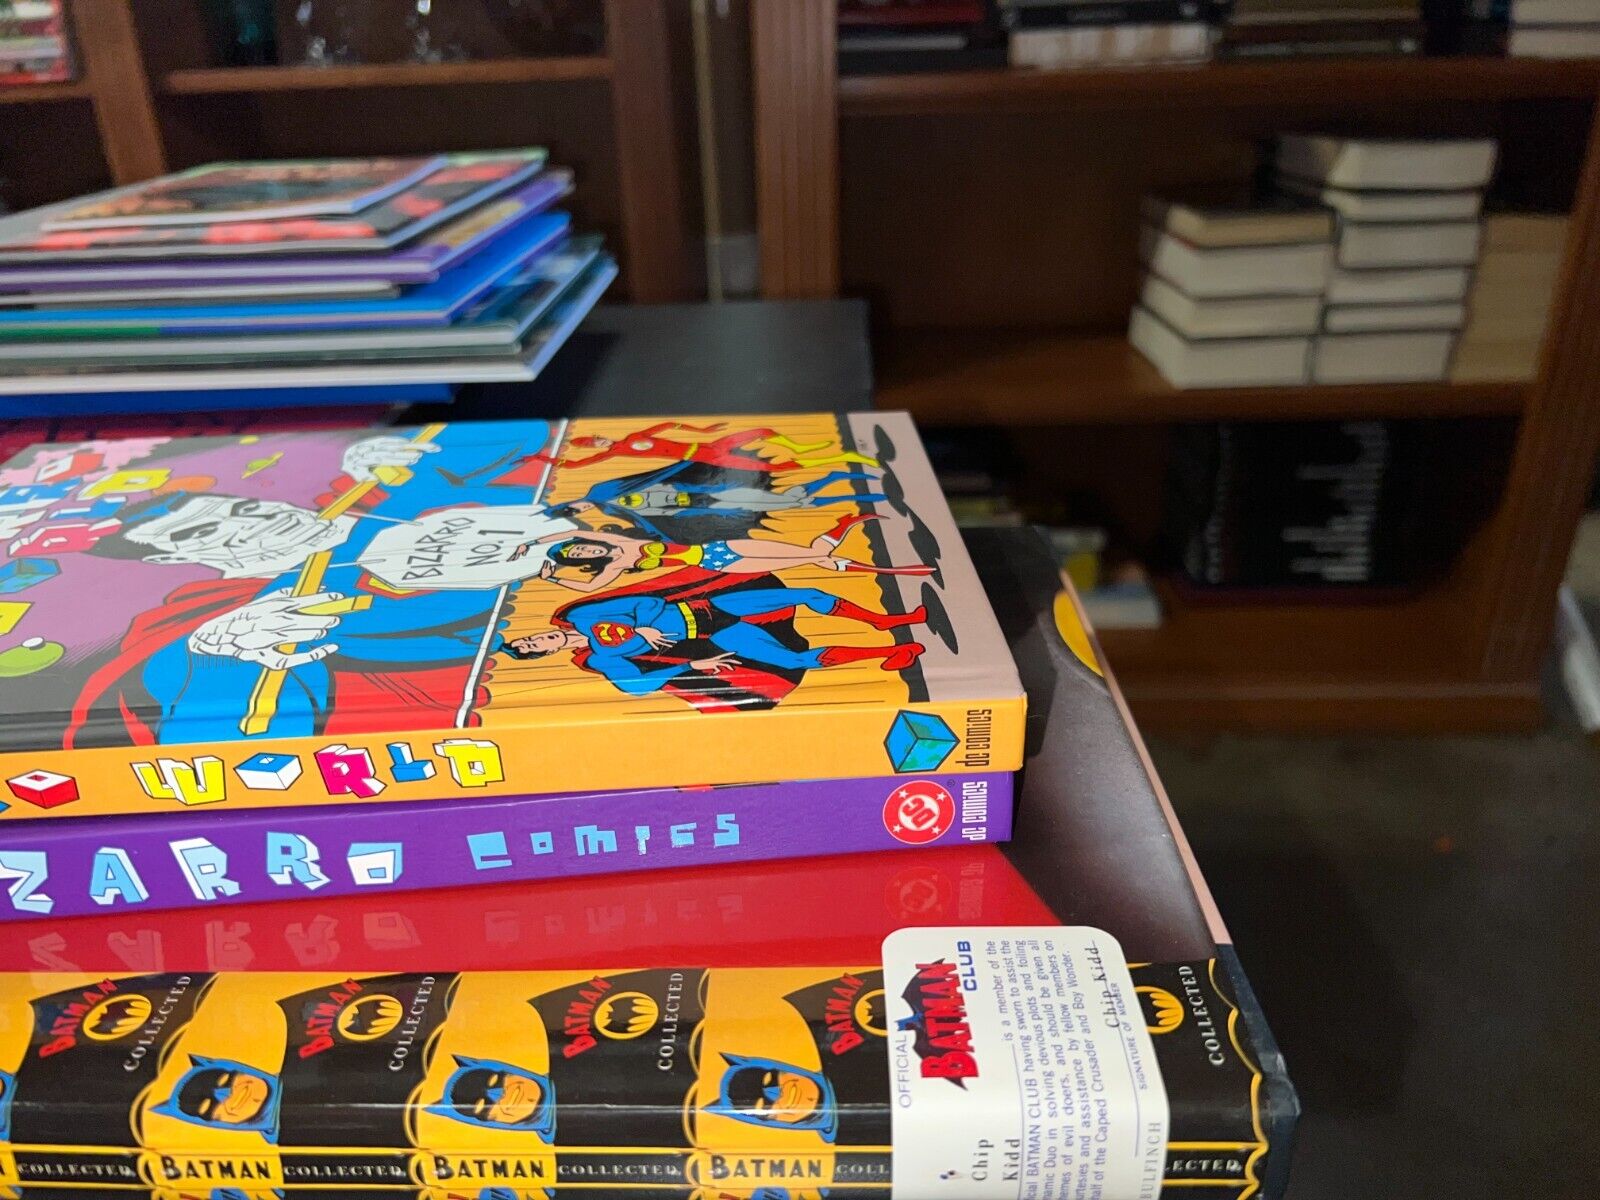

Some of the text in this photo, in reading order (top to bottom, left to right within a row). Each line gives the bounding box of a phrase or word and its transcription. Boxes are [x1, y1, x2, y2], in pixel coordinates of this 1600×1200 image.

[402, 517, 476, 580] BIZARRO
[130, 738, 504, 806] WORLD
[0, 831, 403, 913] ZARRO
[986, 940, 997, 955] the
[1000, 940, 1011, 954] the
[1016, 940, 1028, 968] foiling
[1028, 940, 1039, 951] all
[1044, 940, 1055, 951] on
[957, 940, 977, 991] CLUB
[988, 960, 1000, 968] of
[1003, 957, 1017, 983] assist
[1033, 956, 1049, 981] given
[1048, 954, 1065, 997] members
[993, 975, 1008, 1014] member
[1010, 987, 1021, 997] to
[1021, 973, 1034, 991] and
[1040, 986, 1051, 999] be
[1085, 947, 1120, 1028] Chip Kidd
[825, 972, 865, 1055] BATMAN
[1027, 996, 1042, 1021] plots
[1072, 991, 1085, 1009] Boy
[39, 978, 119, 1058] BATMAN
[123, 975, 192, 1072] COLLECTED
[298, 977, 364, 1058] BATMAN
[388, 976, 436, 1072] COLLECTED
[562, 975, 613, 1058] BATMAN
[657, 972, 684, 1071] COLLECTED
[915, 963, 979, 1079] BATMAN
[1013, 1001, 1027, 1030] sworn
[1042, 1004, 1060, 1038] should
[1060, 1004, 1075, 1033] fellow
[1076, 1014, 1091, 1034] and
[1178, 965, 1225, 1066] COLLECTED
[1004, 1032, 1013, 1041] is
[1034, 1025, 1050, 1066] devious
[1067, 1038, 1080, 1051] by
[1110, 982, 1148, 1090] SIGNATURE OF MEMBER
[1020, 1035, 1035, 1072] having
[1051, 1044, 1066, 1066] and
[1084, 1039, 1104, 1092] Crusader
[896, 1035, 912, 1108] OFFICIAL
[1024, 1078, 1041, 1118] CLUB
[1042, 1070, 1057, 1118] solving
[1072, 1058, 1091, 1128] assistance
[1045, 1128, 1057, 1139] in
[1095, 1099, 1111, 1142] Caped
[1026, 1124, 1041, 1177] BATMAN
[1062, 1125, 1074, 1147] evil
[1079, 1135, 1091, 1158] and
[160, 1155, 272, 1180] BATMAN
[433, 1154, 544, 1180] BATMAN
[556, 1163, 681, 1178] COLLECTED
[709, 1153, 823, 1181] BATMAN
[972, 1139, 994, 1181] Chip
[1003, 1139, 1021, 1181] Kidd
[1043, 1146, 1057, 1168] Duo
[1061, 1154, 1073, 1165] of
[1094, 1147, 1107, 1165] the
[1140, 1122, 1162, 1199] BULFINCH
[1166, 1158, 1242, 1173] ECTED
[283, 1164, 406, 1178] COLLECTED
[1093, 1170, 1104, 1180] of
